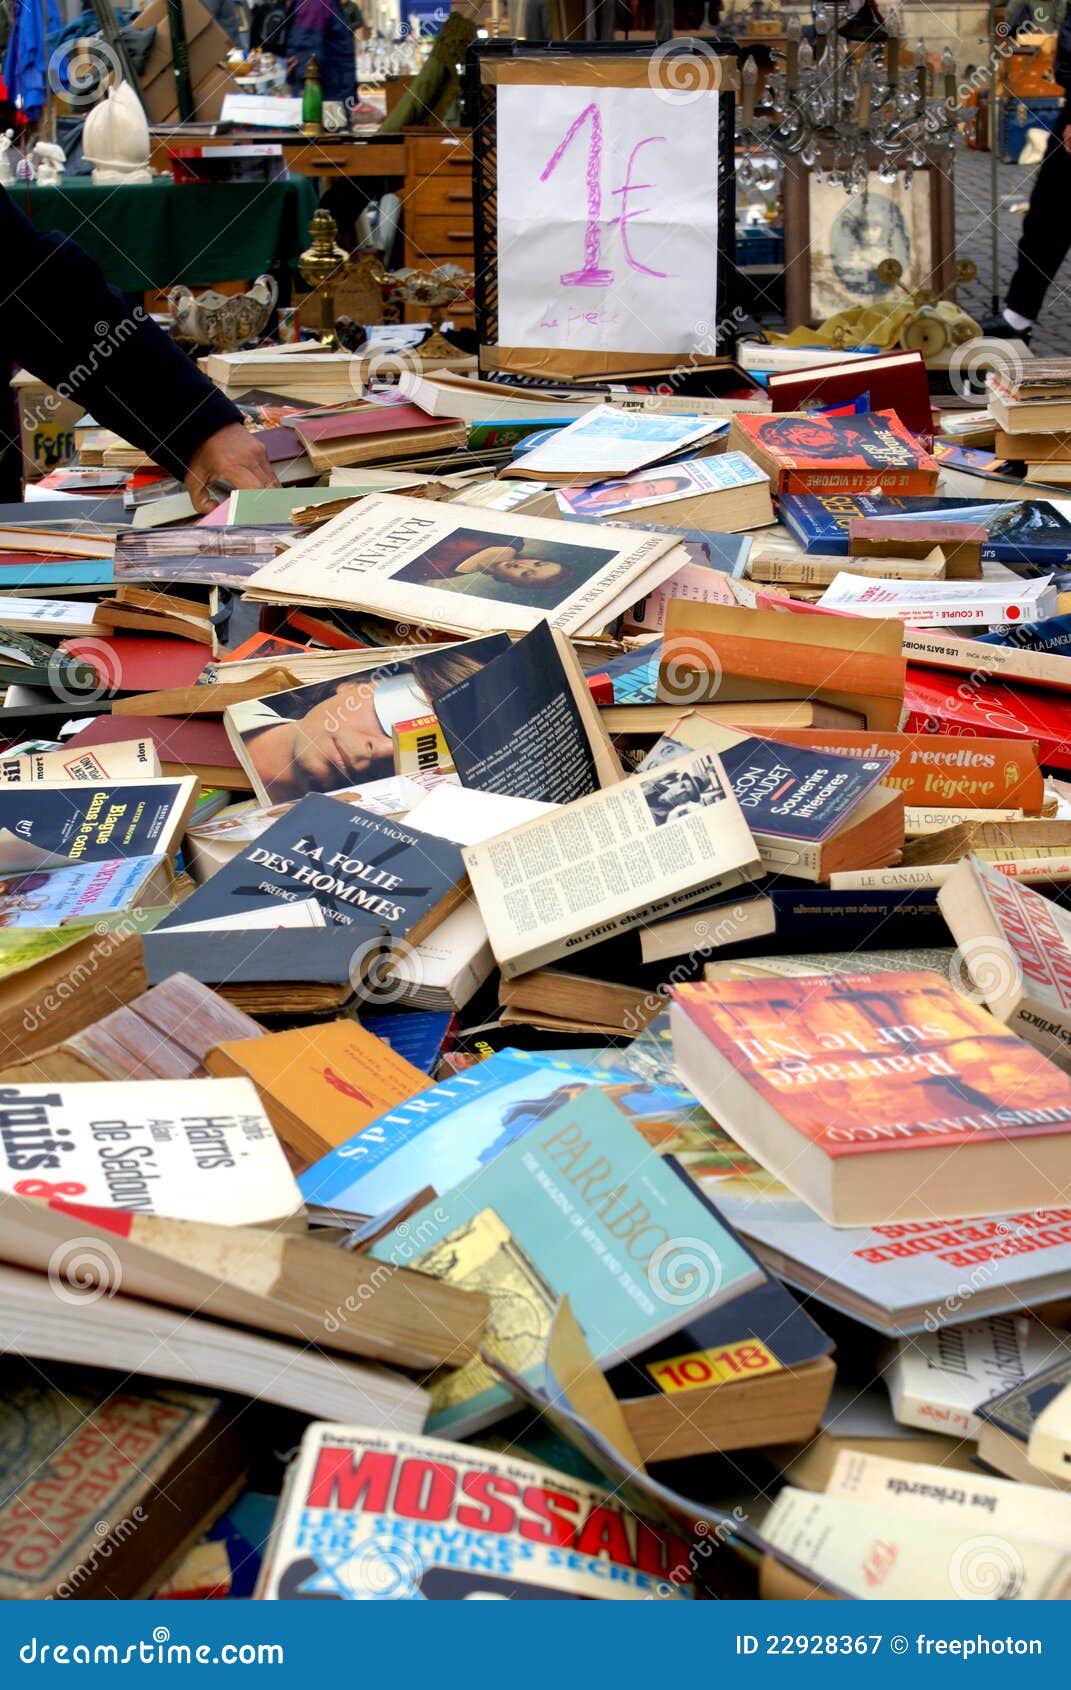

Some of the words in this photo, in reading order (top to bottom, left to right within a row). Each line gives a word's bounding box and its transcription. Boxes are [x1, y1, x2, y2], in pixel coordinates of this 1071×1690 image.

[806, 475, 849, 487] VICTOIRE
[335, 517, 436, 576] RAFFAEL
[941, 610, 973, 618] COUPLE
[926, 645, 944, 654] RATS
[946, 648, 959, 657] LES
[138, 741, 147, 763] plon
[910, 747, 996, 768] recettes
[36, 757, 44, 780] mort
[741, 763, 791, 808] DAUDET
[770, 767, 829, 816] Souvenirs
[792, 772, 849, 820] littéraires
[924, 772, 995, 799] légère
[89, 792, 109, 820] dans
[97, 804, 127, 846] Blague
[69, 832, 95, 860] coin
[292, 835, 326, 862] LA
[327, 848, 403, 896] FOLIE
[860, 876, 875, 886] LE
[882, 872, 934, 885] CANADA
[250, 844, 295, 877] DES
[292, 861, 405, 927] HOMMES
[565, 933, 583, 947] du
[651, 900, 670, 912] les
[671, 880, 723, 904] femmes
[816, 1031, 863, 1056] le
[873, 1020, 946, 1045] sur
[731, 1035, 807, 1064] Nil
[765, 1052, 957, 1090] Barrage
[0, 1088, 76, 1171] Juifs
[89, 1119, 145, 1143] de
[147, 1118, 179, 1144] Alain
[337, 1075, 482, 1161] SPIRIT
[825, 1119, 914, 1142] JACQ
[924, 1104, 1071, 1136] HRISTIAN
[181, 1115, 250, 1171] Harris
[657, 1357, 713, 1389] 10
[715, 1344, 772, 1375] 18
[14, 1402, 179, 1571] MEMENTO
[886, 1477, 965, 1508] tricards
[306, 1446, 693, 1584] MOSSAD
[971, 1494, 997, 1513] les
[302, 1510, 355, 1533] LES
[374, 1514, 534, 1559] SERVICES
